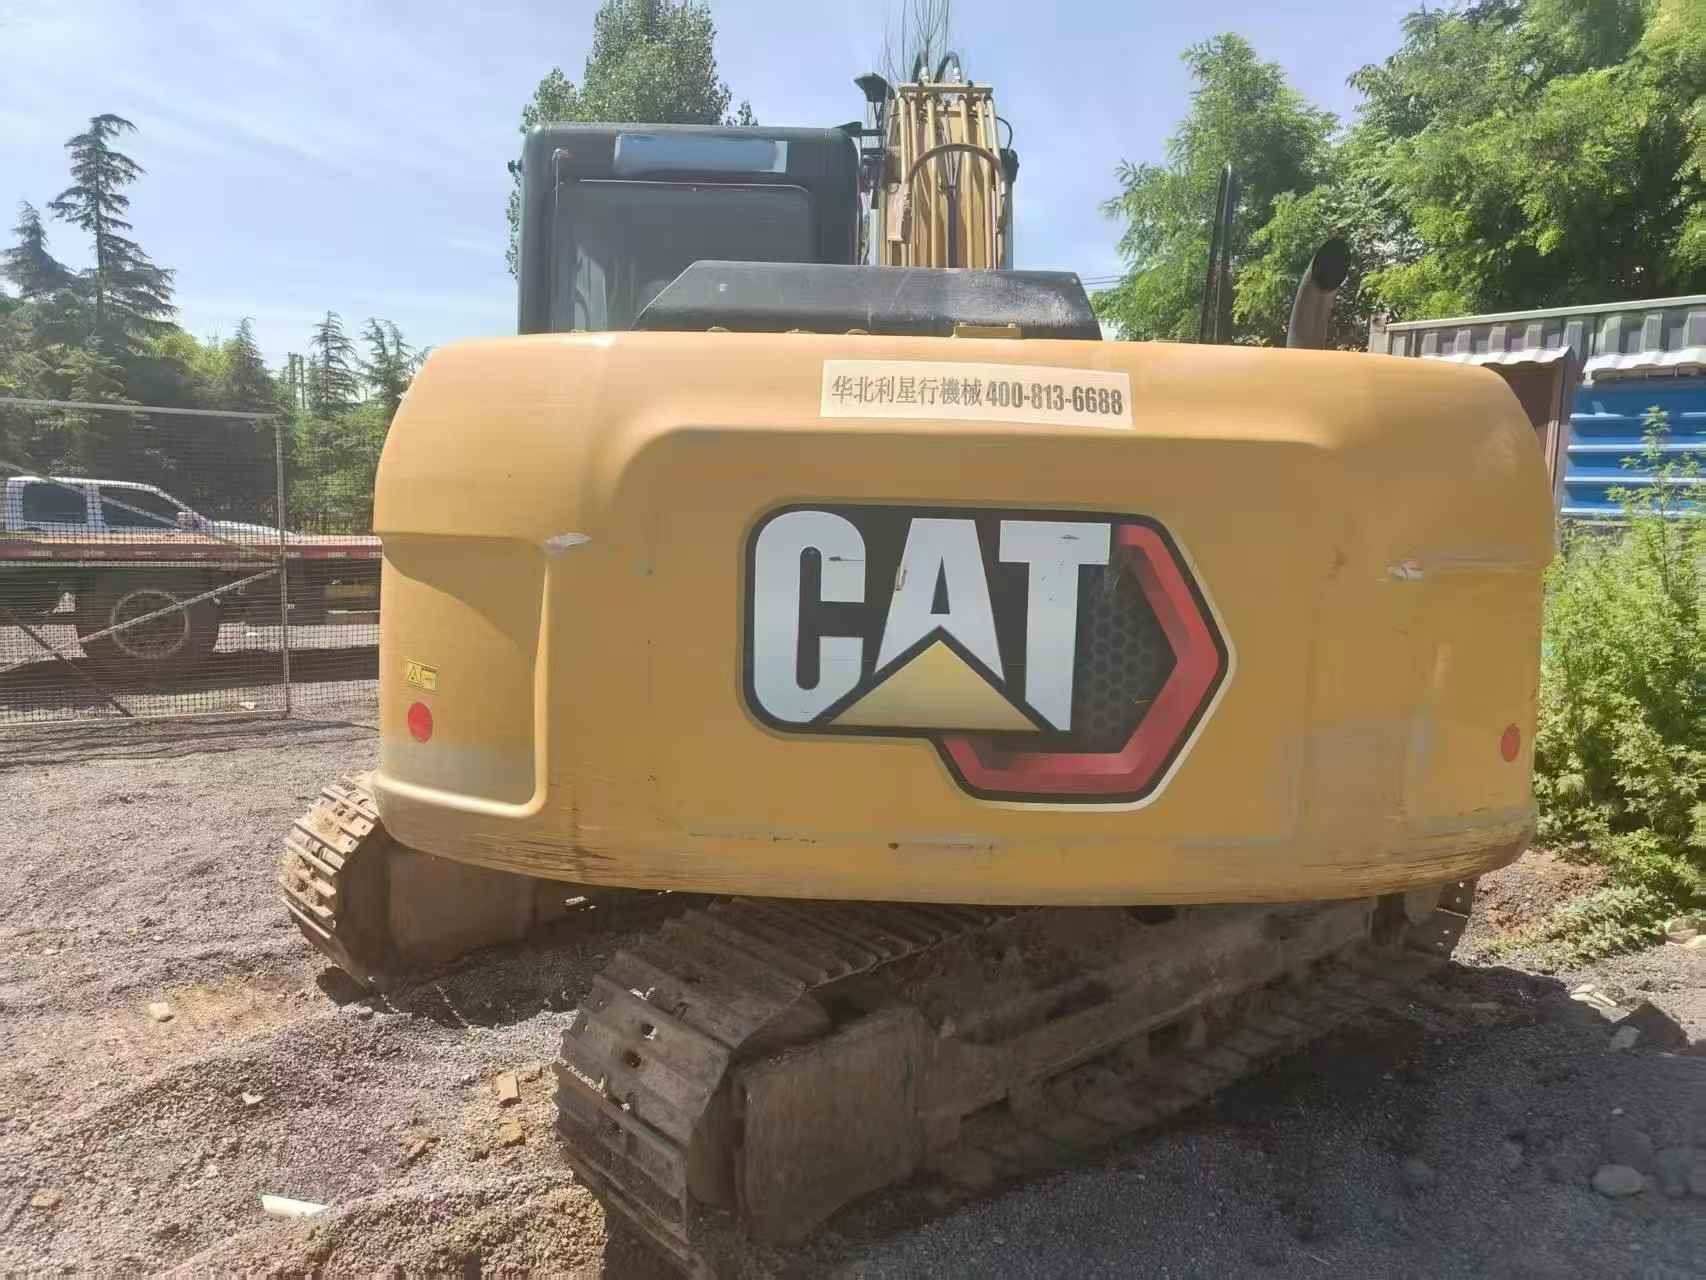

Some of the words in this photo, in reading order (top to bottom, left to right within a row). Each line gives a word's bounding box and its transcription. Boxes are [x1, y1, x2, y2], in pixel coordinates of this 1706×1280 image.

[831, 374, 983, 407] 华北利星行機械
[985, 381, 1123, 416] 400-813-6688
[754, 510, 1111, 731] CAT
